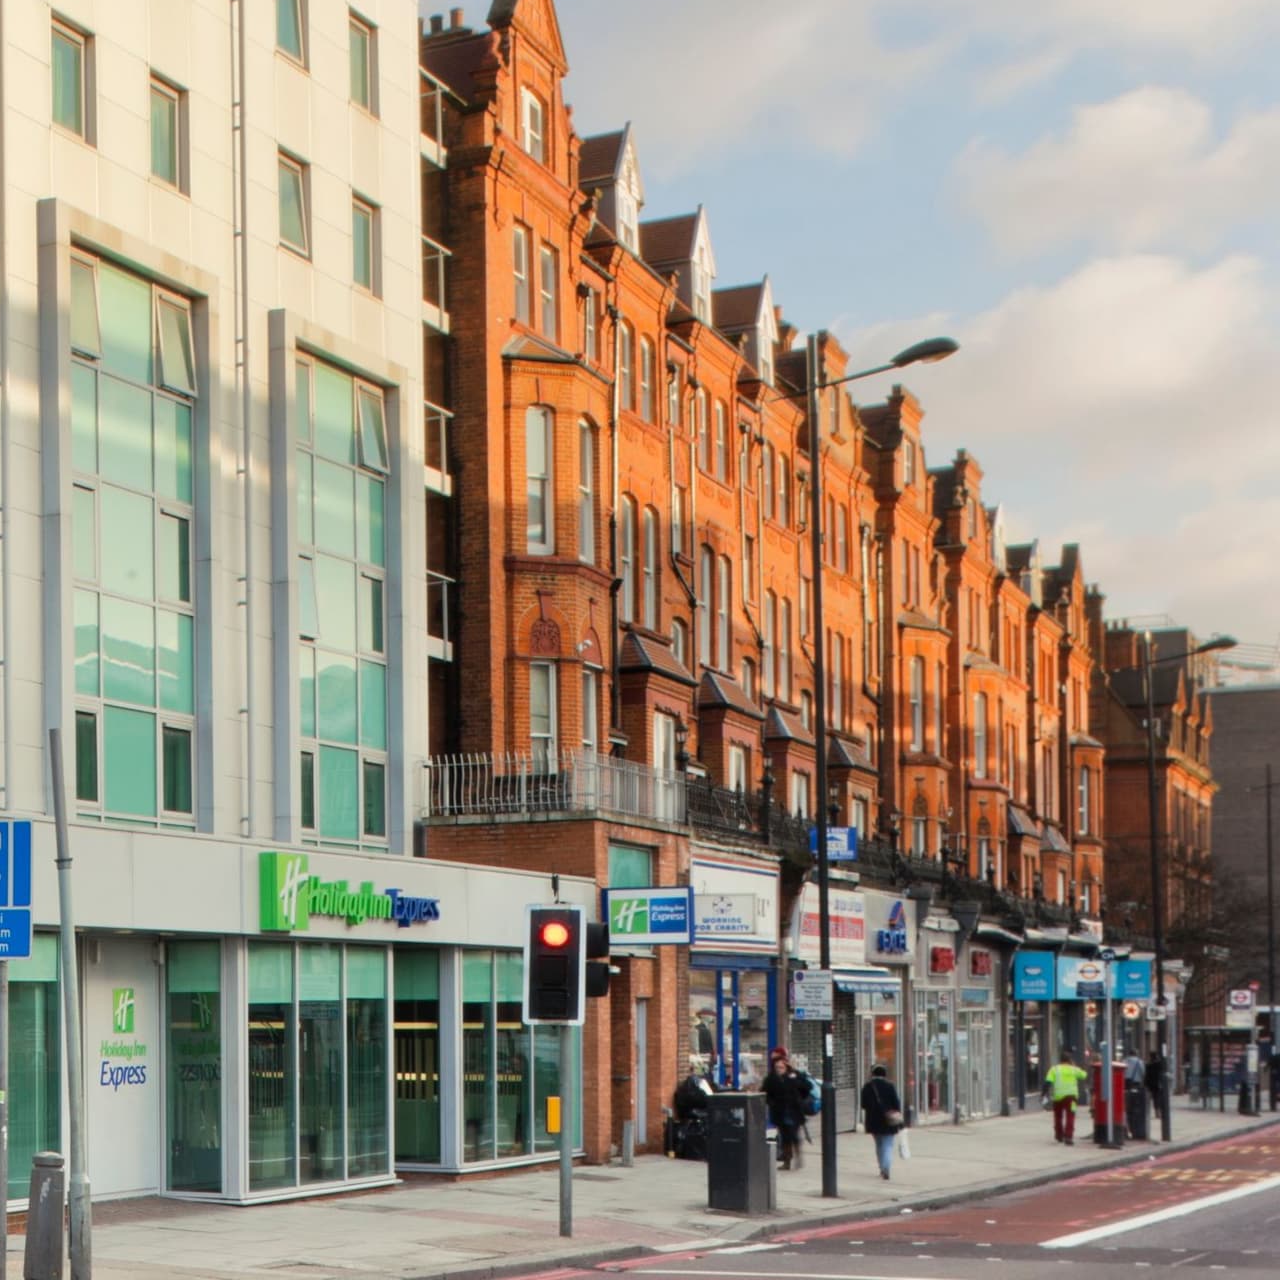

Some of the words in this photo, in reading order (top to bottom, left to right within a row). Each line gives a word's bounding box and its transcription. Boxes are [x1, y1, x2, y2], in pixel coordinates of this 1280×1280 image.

[308, 876, 367, 925] Holiday
[389, 891, 439, 927] Express
[651, 912, 686, 923] Express
[99, 1040, 133, 1060] Holiday
[134, 1040, 147, 1057] Inn
[100, 1061, 147, 1092] Express
